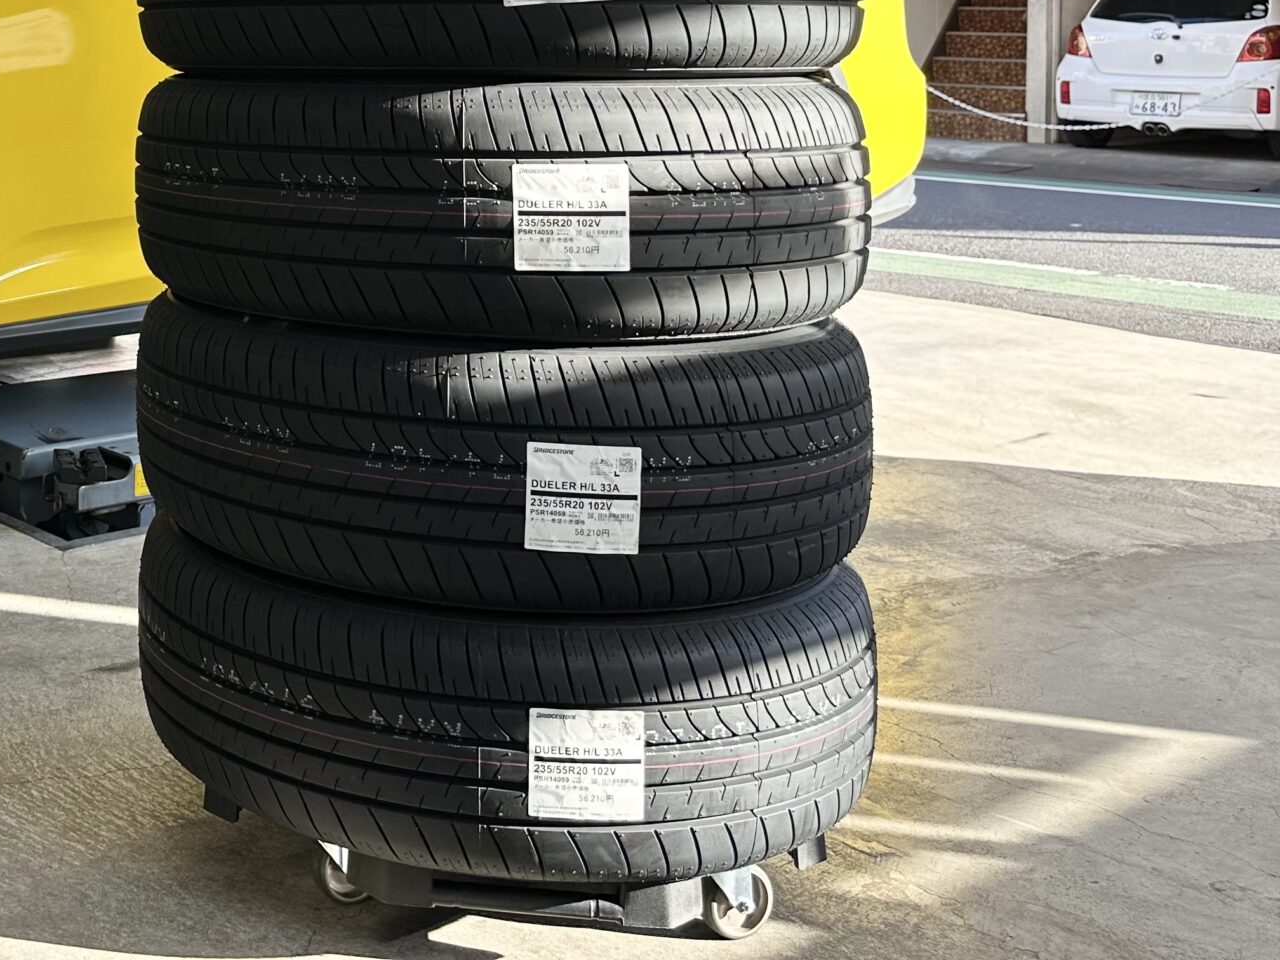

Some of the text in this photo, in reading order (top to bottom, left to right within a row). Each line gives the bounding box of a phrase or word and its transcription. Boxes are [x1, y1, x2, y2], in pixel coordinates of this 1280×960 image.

[518, 200, 608, 209] DUELER H/L 33A
[517, 218, 601, 228] 235/55R20 102V
[533, 447, 575, 455] BRIDGESTONE
[531, 479, 620, 493] DUELER H/L 33A
[530, 498, 613, 511] 235/55R20 102V
[530, 509, 566, 517] PSR14059
[534, 745, 623, 757] DUELER H/L 33A
[533, 764, 617, 776] 235/55R20 102V
